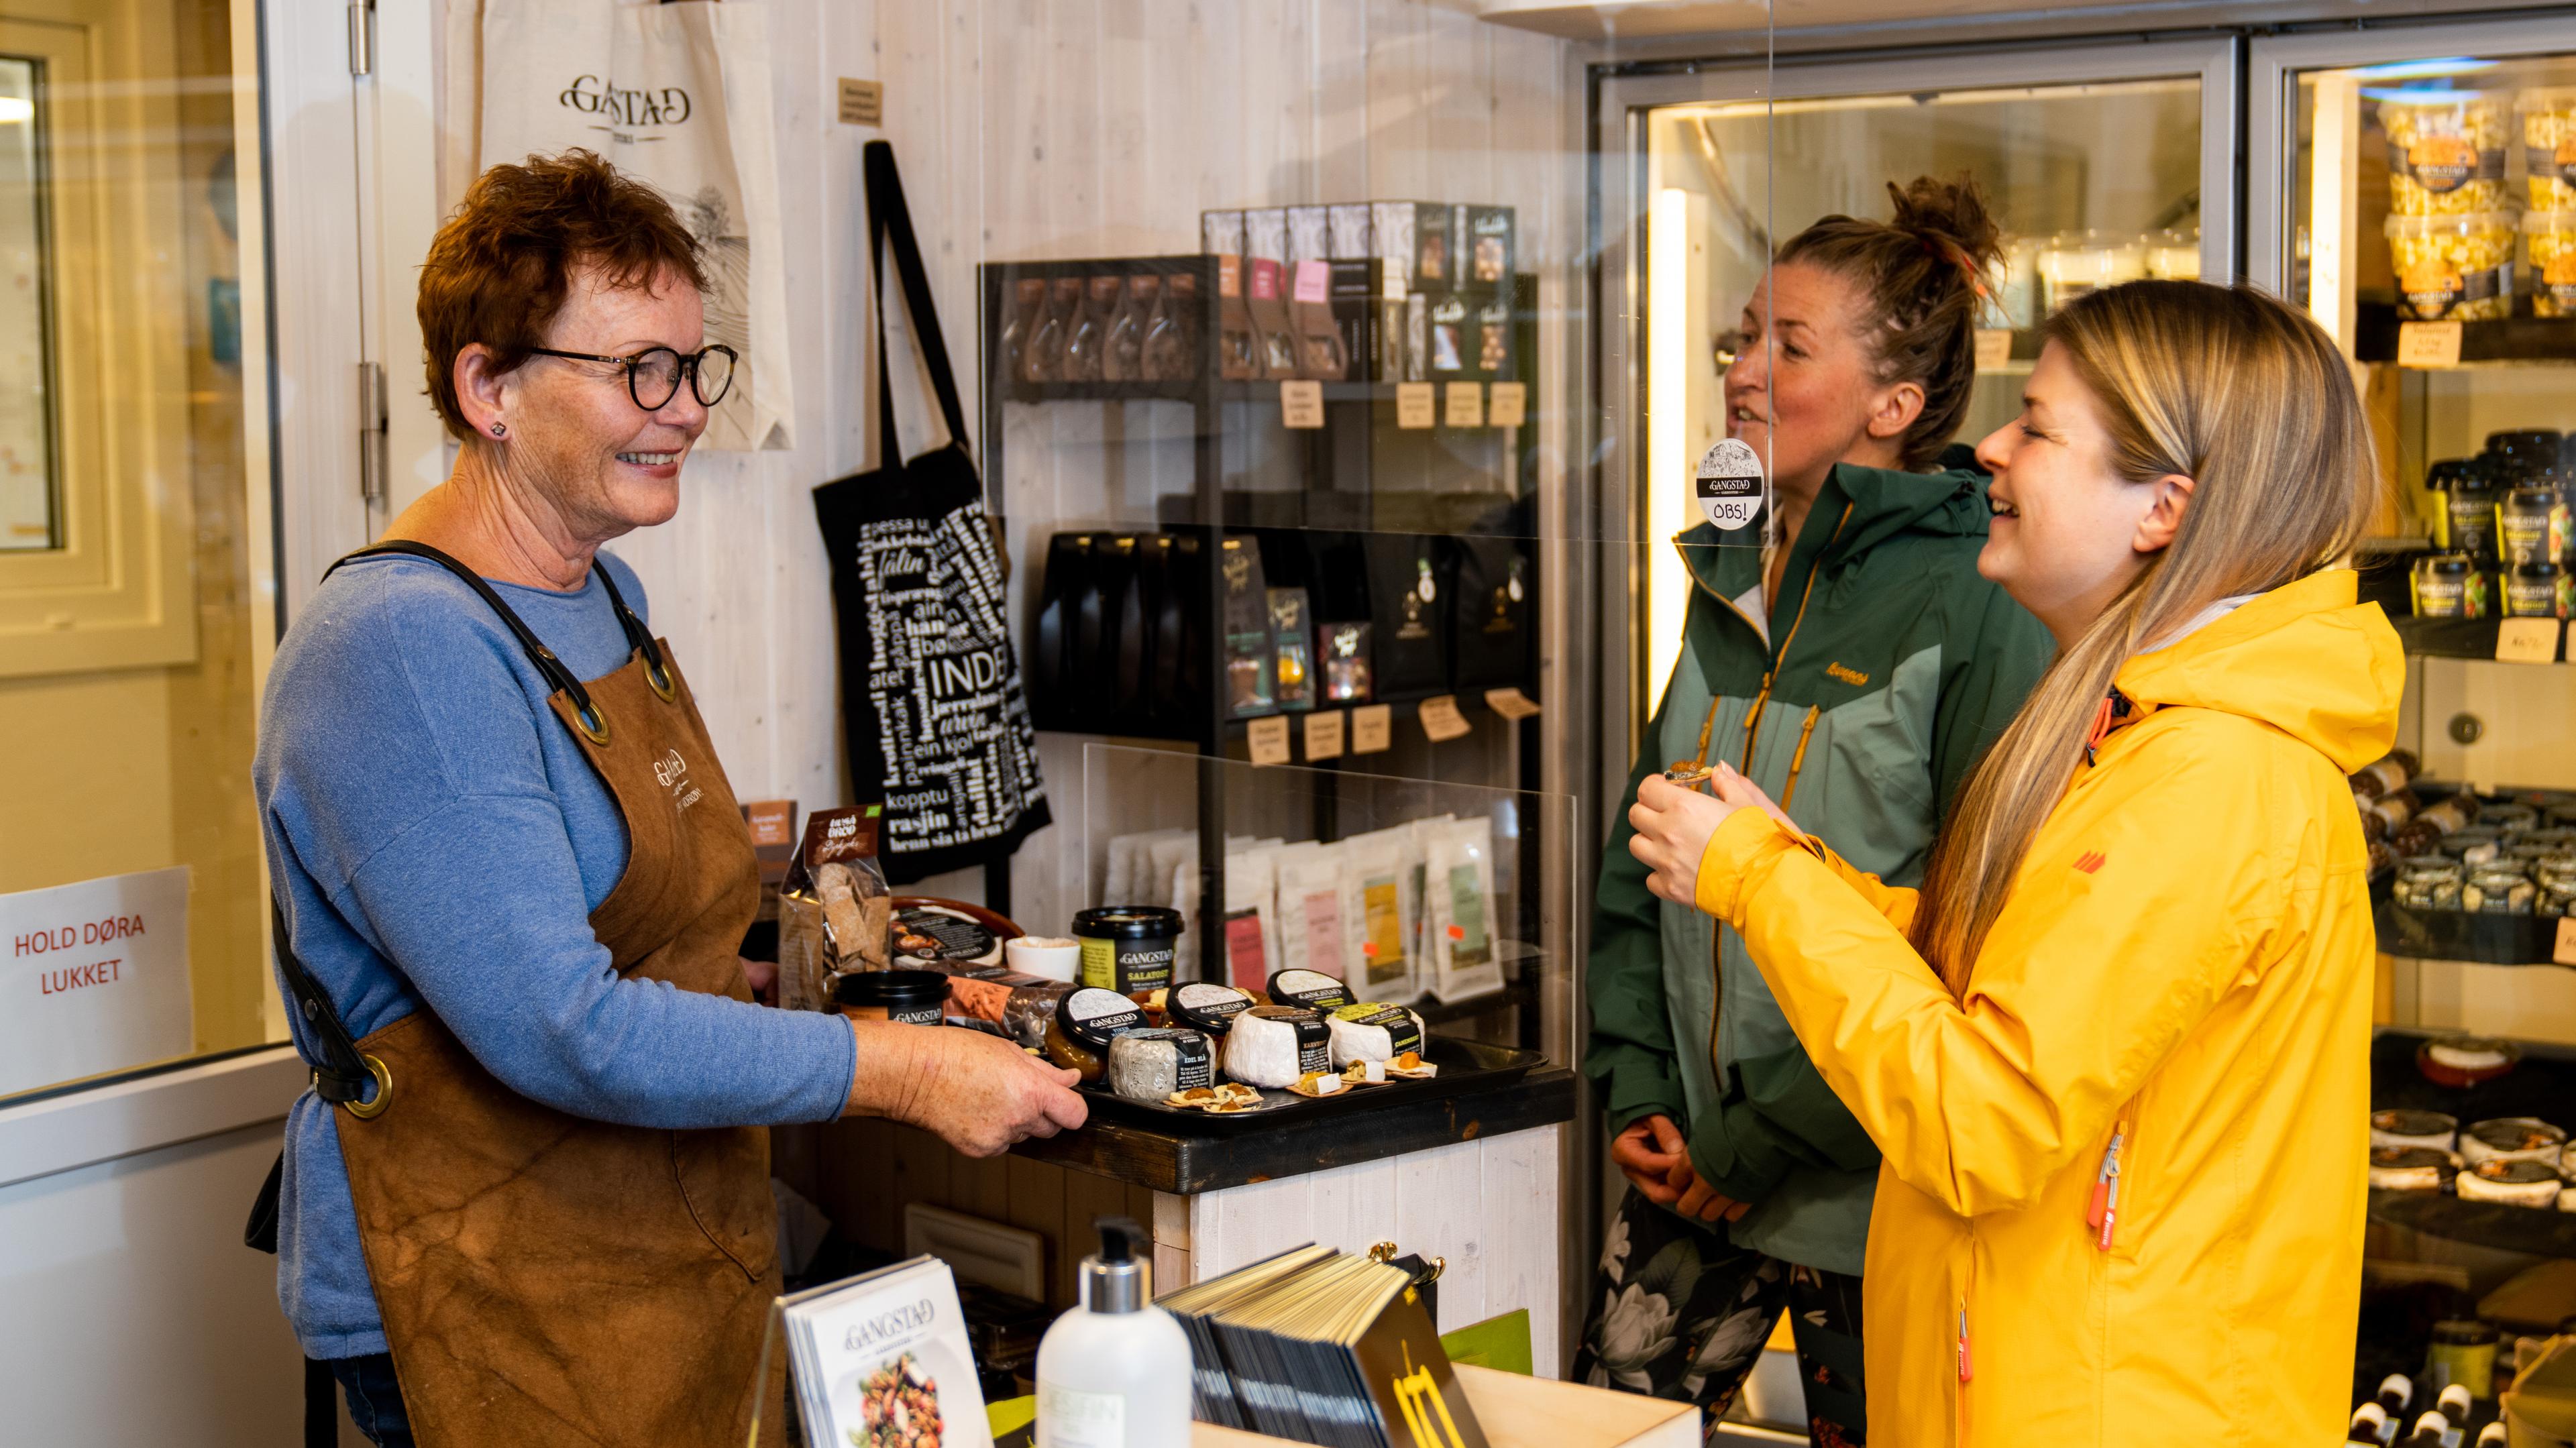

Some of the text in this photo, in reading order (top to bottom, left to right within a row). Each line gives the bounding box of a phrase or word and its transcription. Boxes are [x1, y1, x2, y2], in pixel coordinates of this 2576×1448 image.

[1709, 480, 1750, 490] GANGSTAD
[1714, 502, 1747, 521] OBS!
[15, 913, 146, 958] HOLD DØRA
[1119, 949, 1173, 964] GANGSTAD
[42, 958, 123, 995] LUKKET
[1089, 1013, 1138, 1027] GANGSTAD
